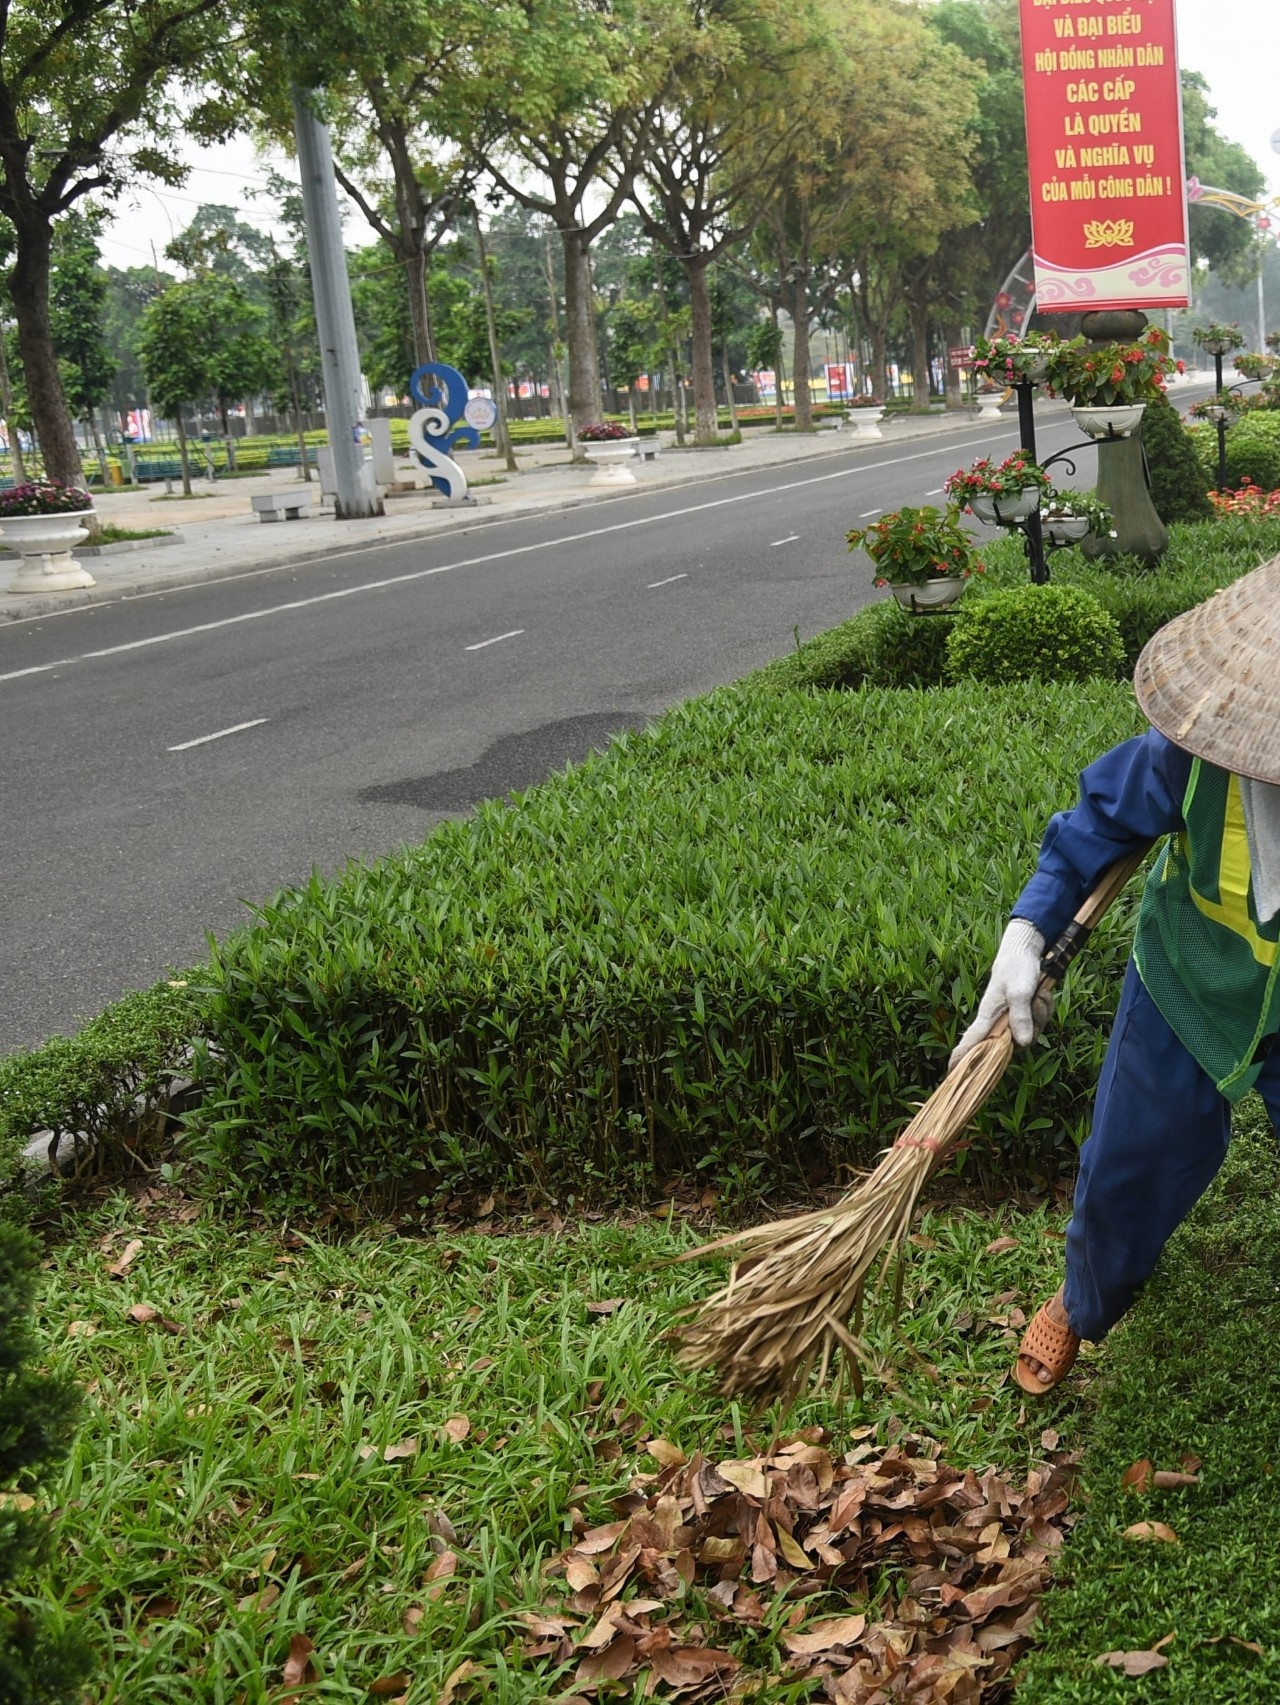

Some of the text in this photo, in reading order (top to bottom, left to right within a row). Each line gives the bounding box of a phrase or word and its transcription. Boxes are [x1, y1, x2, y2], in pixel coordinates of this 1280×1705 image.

[1053, 7, 1142, 40] VÀ ĐẠI BIỂU
[1035, 43, 1164, 75] HỘI ĐỒNG NHÂN DÂN
[1066, 74, 1136, 103] CÁC CẤP
[1064, 112, 1085, 136] LÀ
[1055, 142, 1155, 169] VÀ NGHĨA VỤ
[1042, 176, 1068, 203] CỦA
[1070, 173, 1096, 201] MỖI
[1098, 175, 1134, 199] CÔNG
[1136, 172, 1164, 197] DÂN
